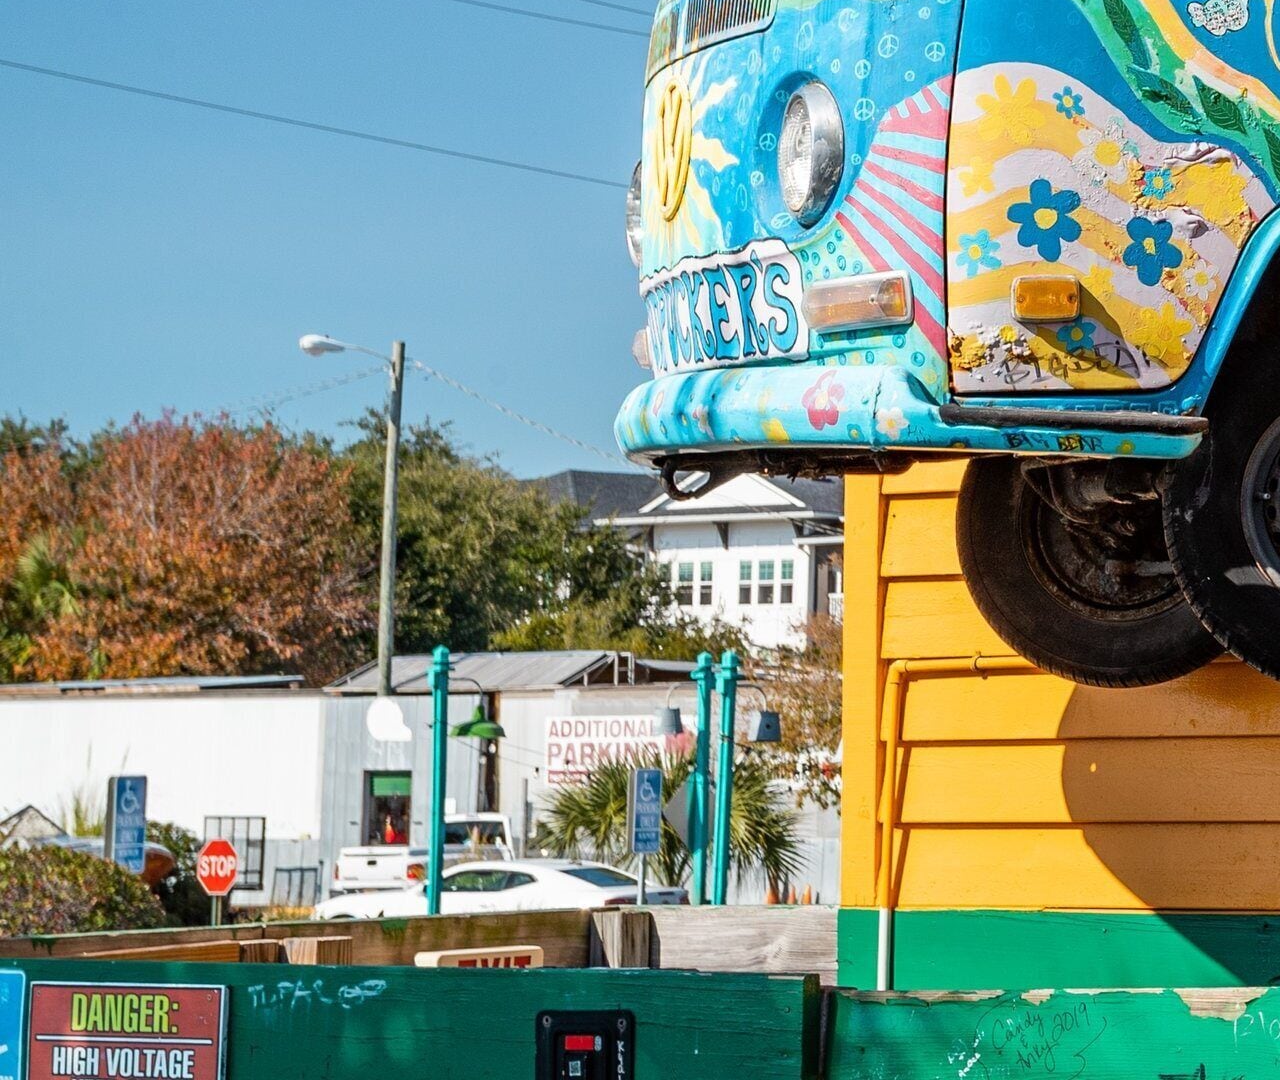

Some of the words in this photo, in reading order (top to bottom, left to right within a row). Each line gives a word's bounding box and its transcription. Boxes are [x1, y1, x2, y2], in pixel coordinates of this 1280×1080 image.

[548, 719, 655, 739] ADDITIONAL
[199, 855, 237, 878] STOP
[70, 992, 181, 1034] DANGER:
[52, 1045, 101, 1076] HIGH
[106, 1046, 196, 1080] VOLTAGE
